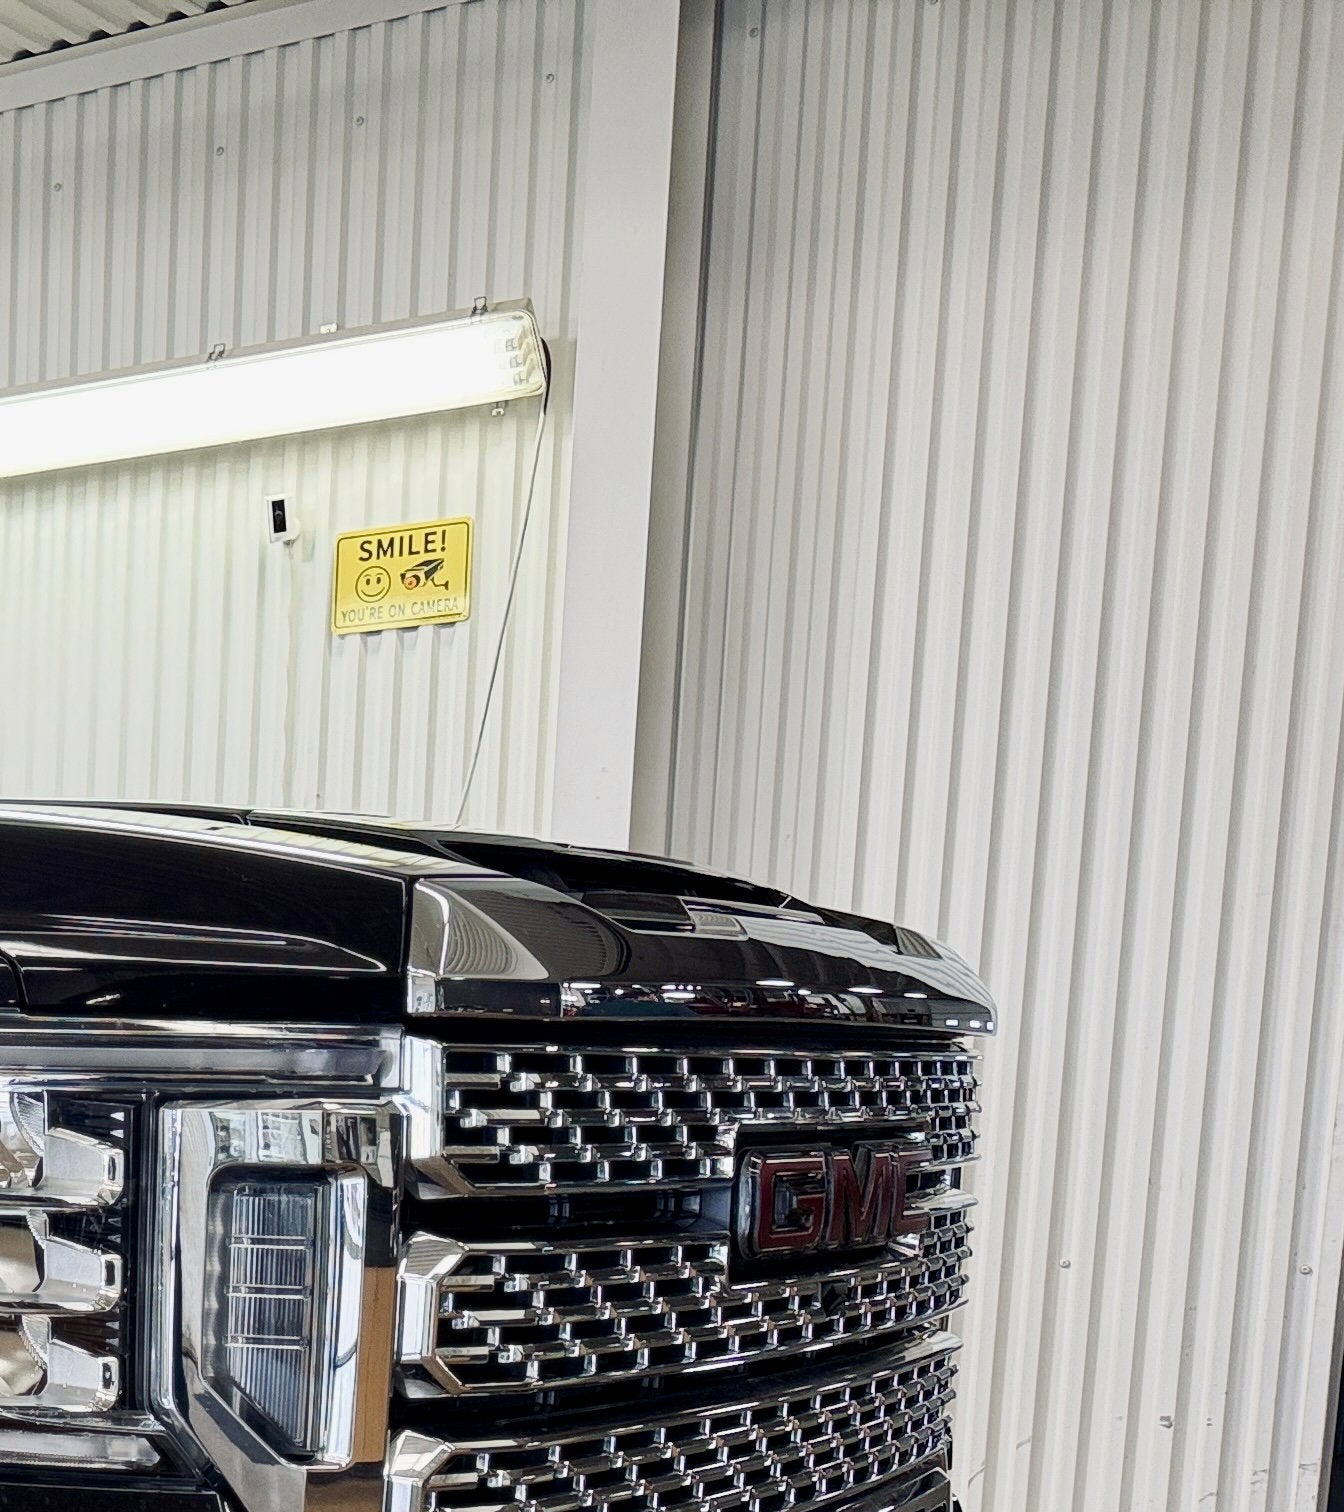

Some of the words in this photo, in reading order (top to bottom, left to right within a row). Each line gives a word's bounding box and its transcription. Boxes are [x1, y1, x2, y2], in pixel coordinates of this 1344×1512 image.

[358, 529, 447, 562] SMILE!
[341, 605, 383, 624] YOU'RE
[388, 603, 406, 618] ON
[411, 597, 459, 616] CAMERA
[750, 1148, 933, 1254] GMC
